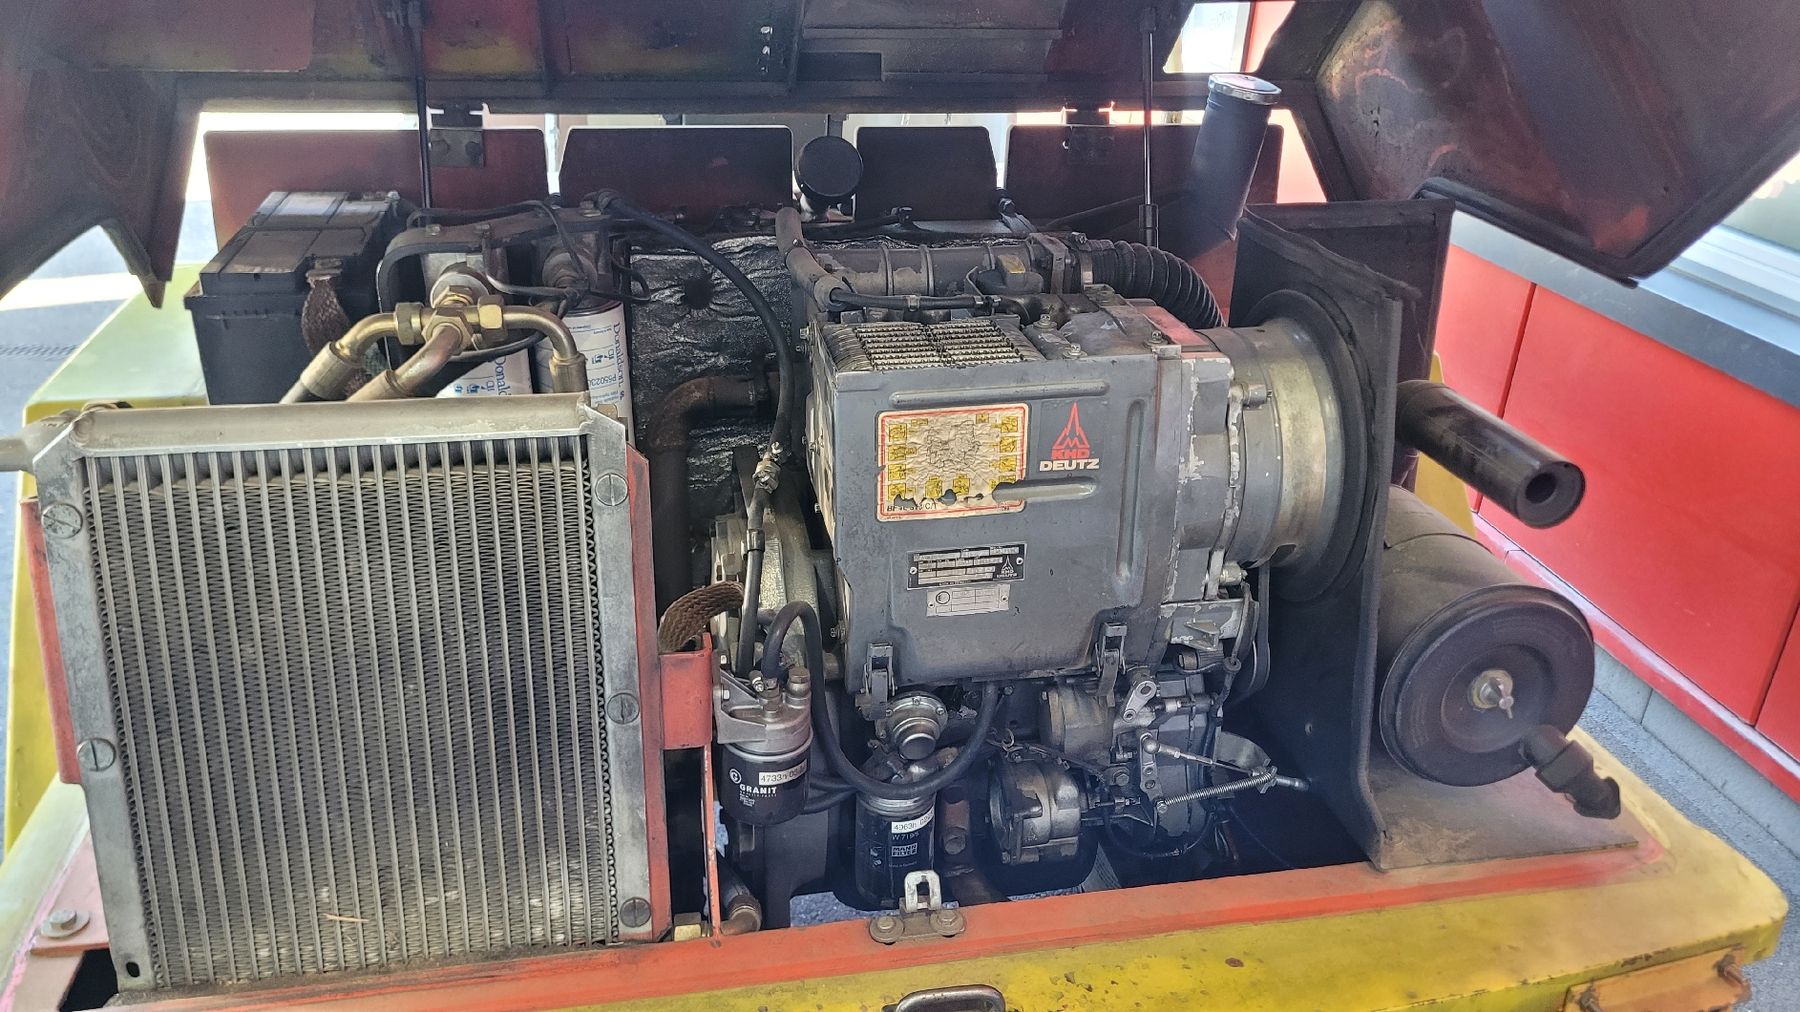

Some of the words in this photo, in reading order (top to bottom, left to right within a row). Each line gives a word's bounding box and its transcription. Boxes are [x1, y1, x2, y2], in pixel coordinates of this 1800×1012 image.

[1052, 449, 1089, 460] KHD
[1039, 458, 1100, 471] DEUTZ
[740, 784, 777, 794] GRANIT
